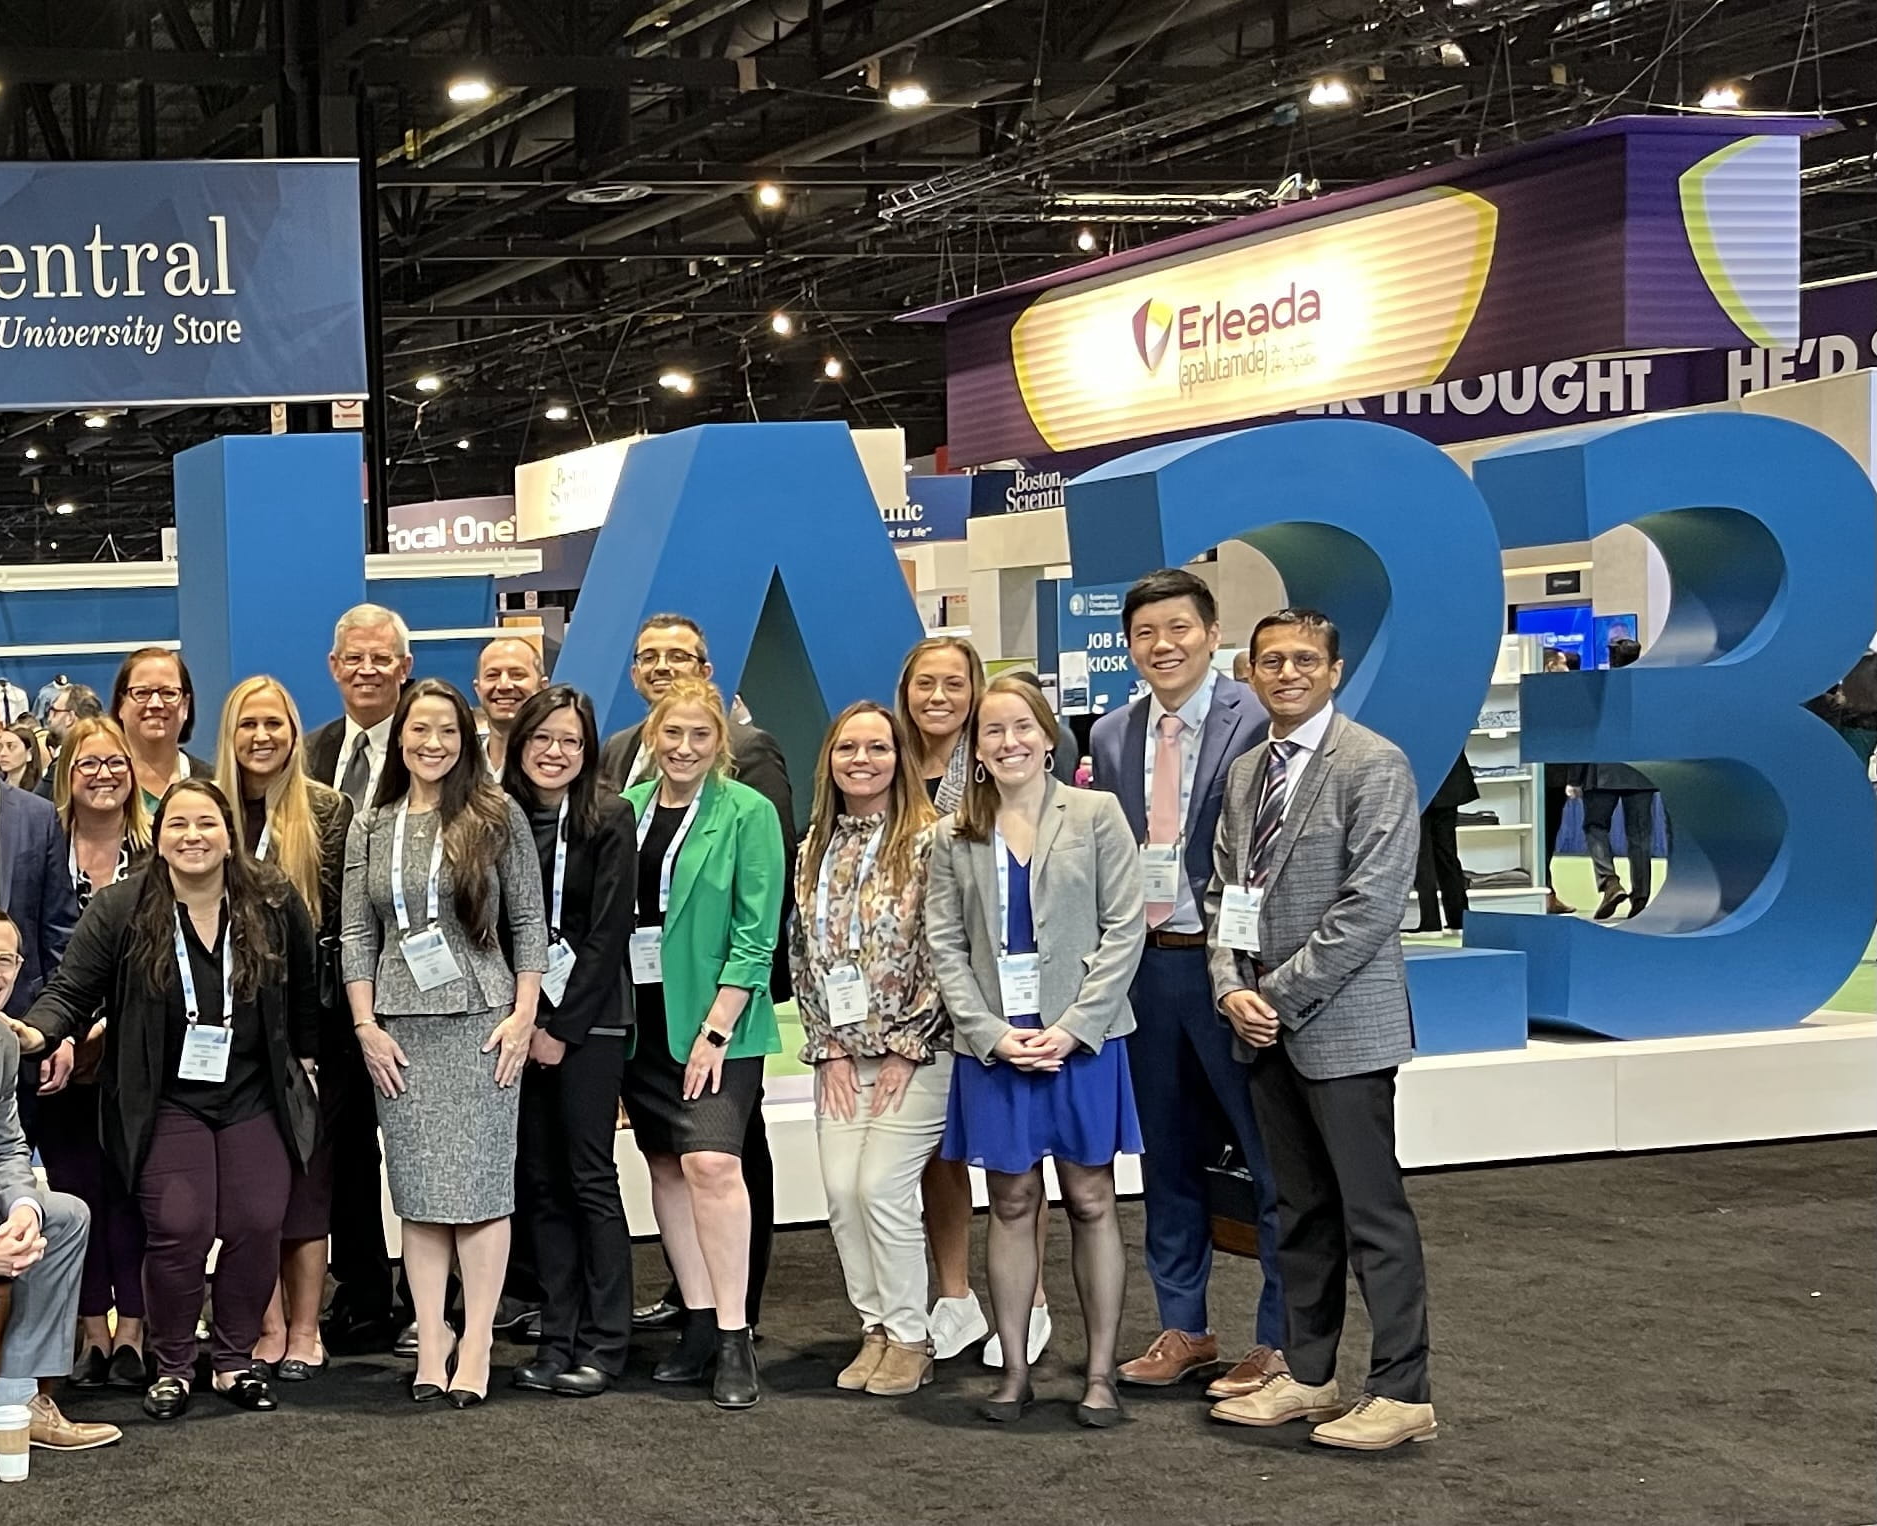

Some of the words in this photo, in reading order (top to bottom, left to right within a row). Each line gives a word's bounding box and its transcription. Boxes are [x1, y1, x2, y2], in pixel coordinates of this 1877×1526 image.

[1179, 281, 1321, 351] Erleada
[173, 313, 242, 345] Store
[1015, 470, 1061, 493] Boston
[1087, 632, 1112, 649] JOB
[1088, 655, 1128, 672] KIOSK
